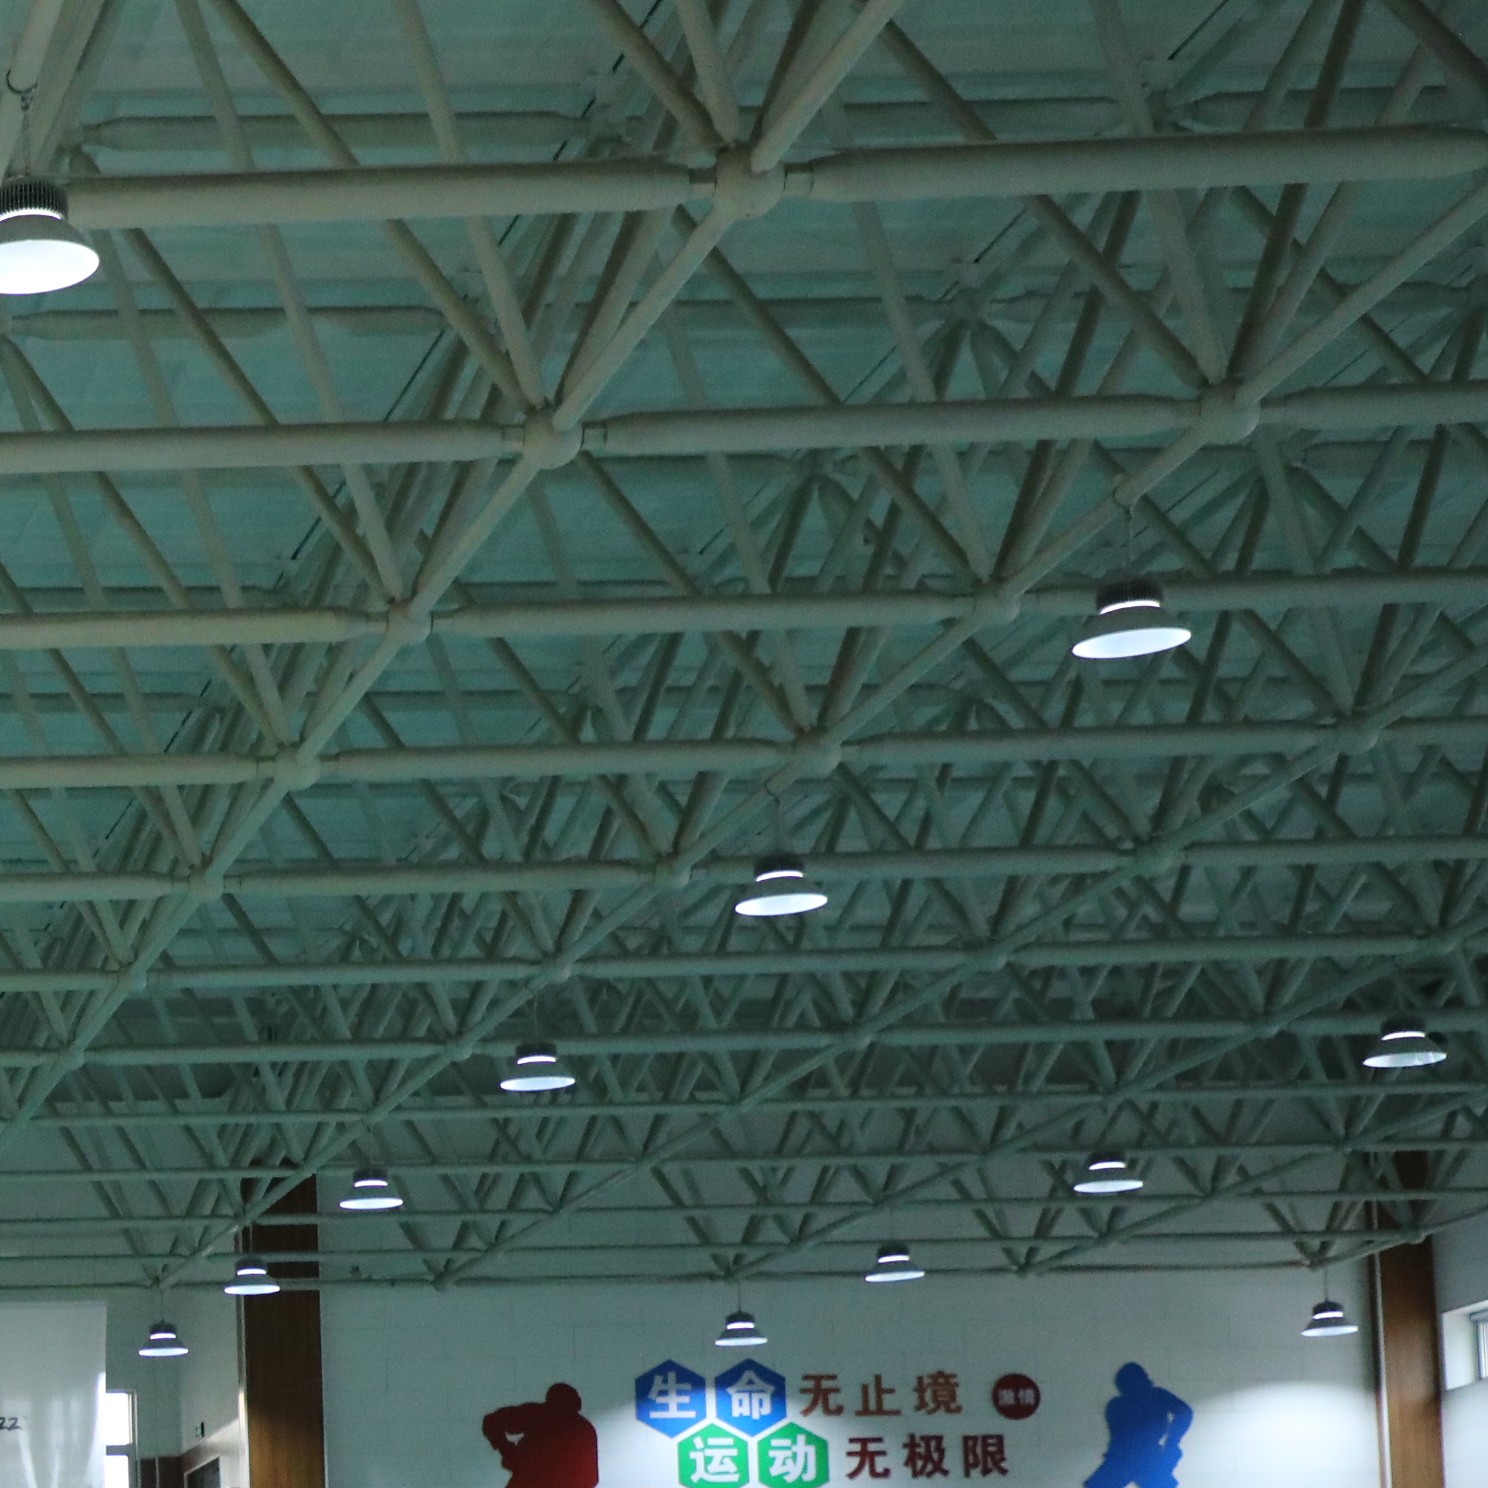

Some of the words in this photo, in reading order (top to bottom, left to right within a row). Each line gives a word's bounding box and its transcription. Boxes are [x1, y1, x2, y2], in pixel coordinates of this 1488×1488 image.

[648, 1370, 776, 1420] 生命
[799, 1370, 963, 1417] 无止境
[689, 1434, 817, 1484] 运动
[846, 1433, 1009, 1479] 无极限
